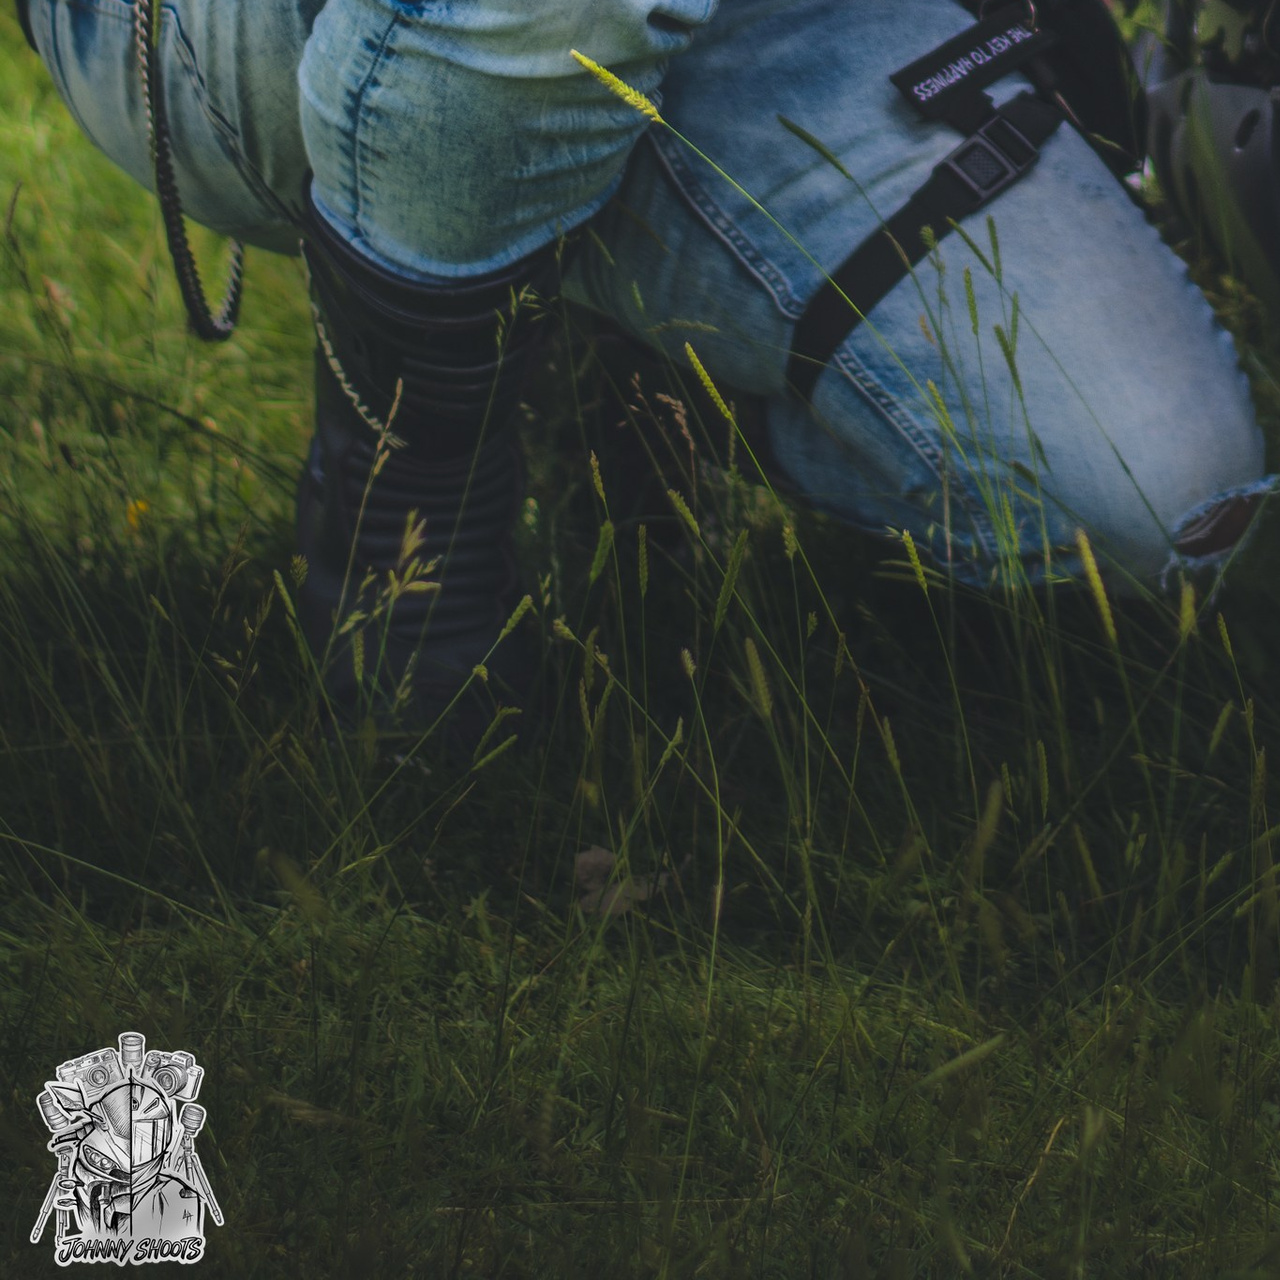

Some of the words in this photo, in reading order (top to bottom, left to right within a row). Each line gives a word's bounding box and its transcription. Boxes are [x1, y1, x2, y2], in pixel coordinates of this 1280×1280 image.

[1006, 25, 1033, 44] THE
[986, 34, 1012, 56] KEY
[970, 46, 992, 65] TO
[913, 56, 975, 101] HAPPINESS
